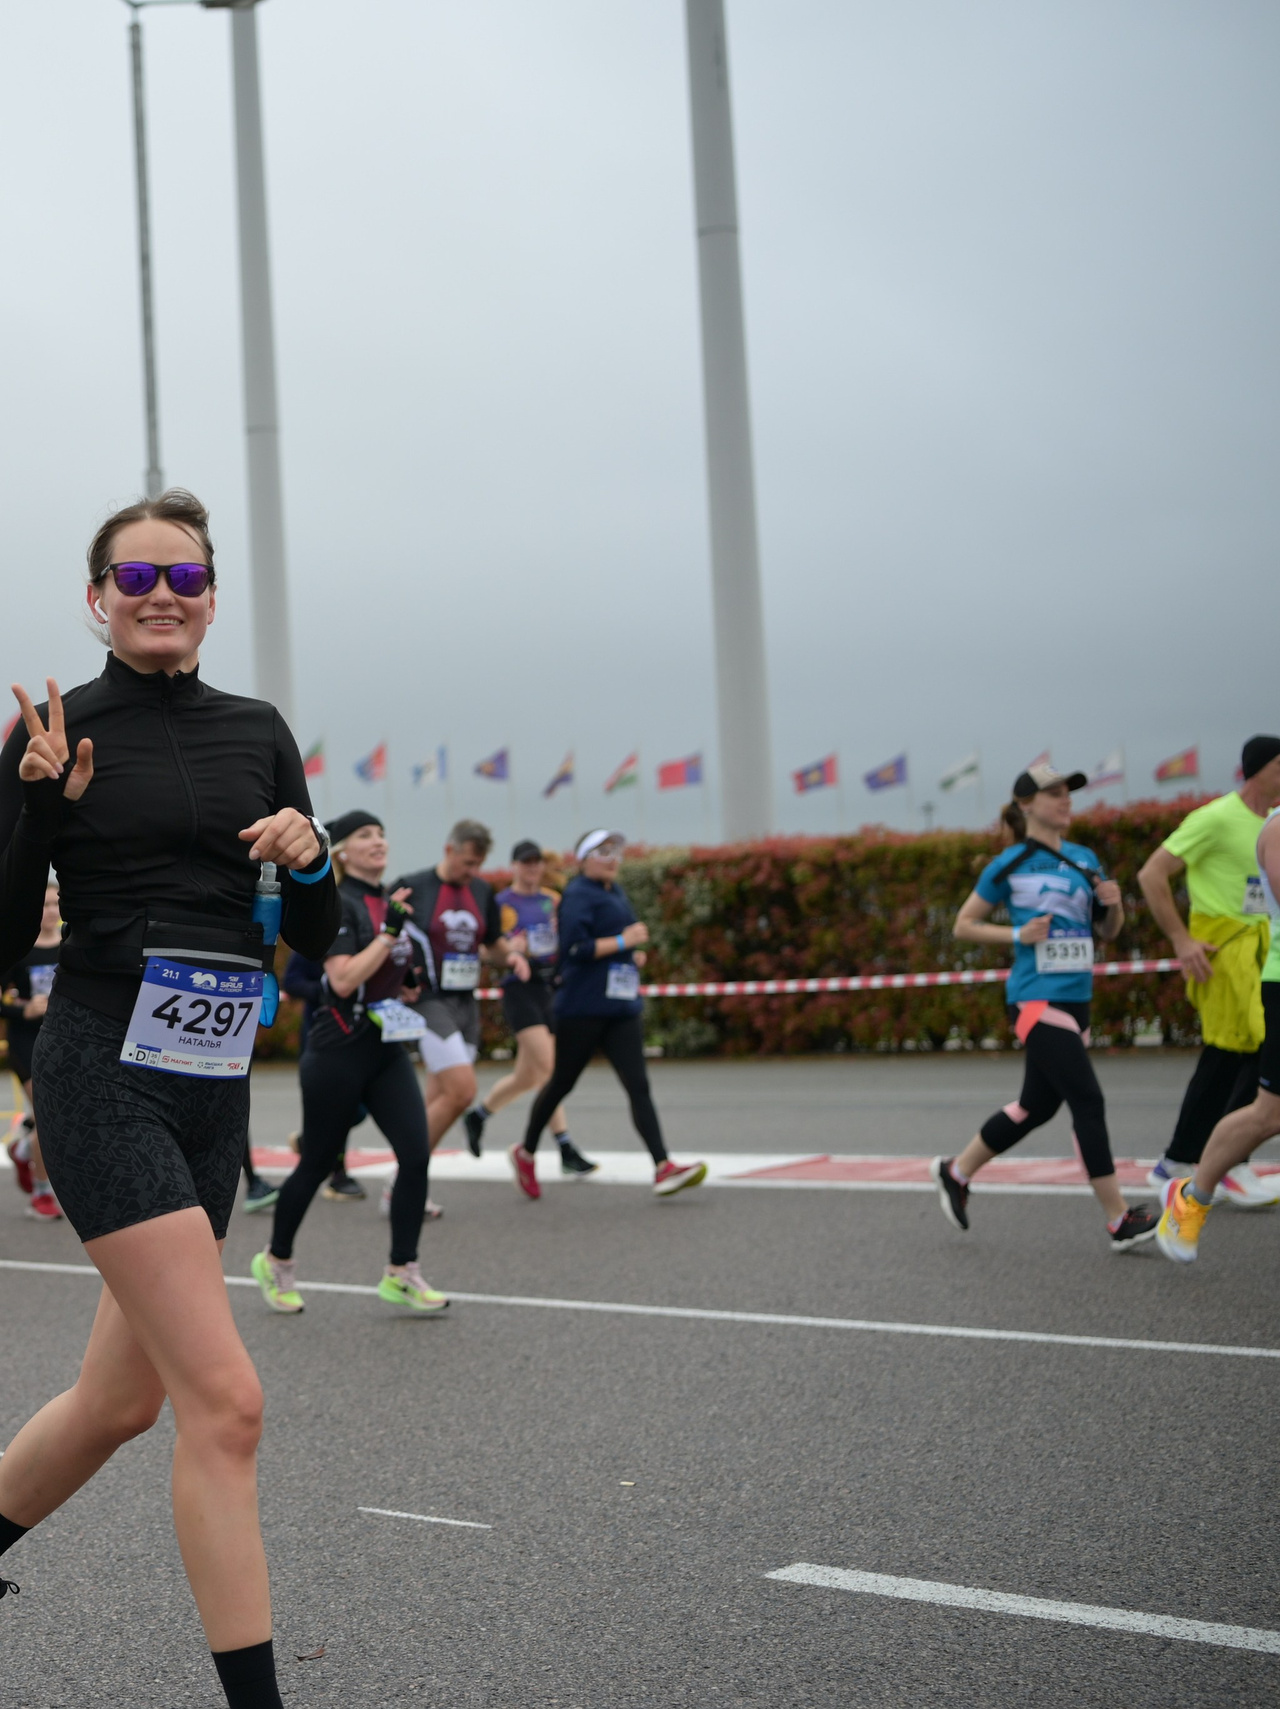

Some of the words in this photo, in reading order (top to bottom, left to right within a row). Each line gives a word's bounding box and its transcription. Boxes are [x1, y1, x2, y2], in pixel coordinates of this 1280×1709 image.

[1045, 942, 1088, 960] 5331
[161, 968, 180, 980] 21.1
[151, 994, 254, 1037] 4297
[178, 1036, 222, 1048] НАТАЛЬЯ
[135, 1050, 147, 1062] D
[170, 1058, 194, 1066] МАГНИТ
